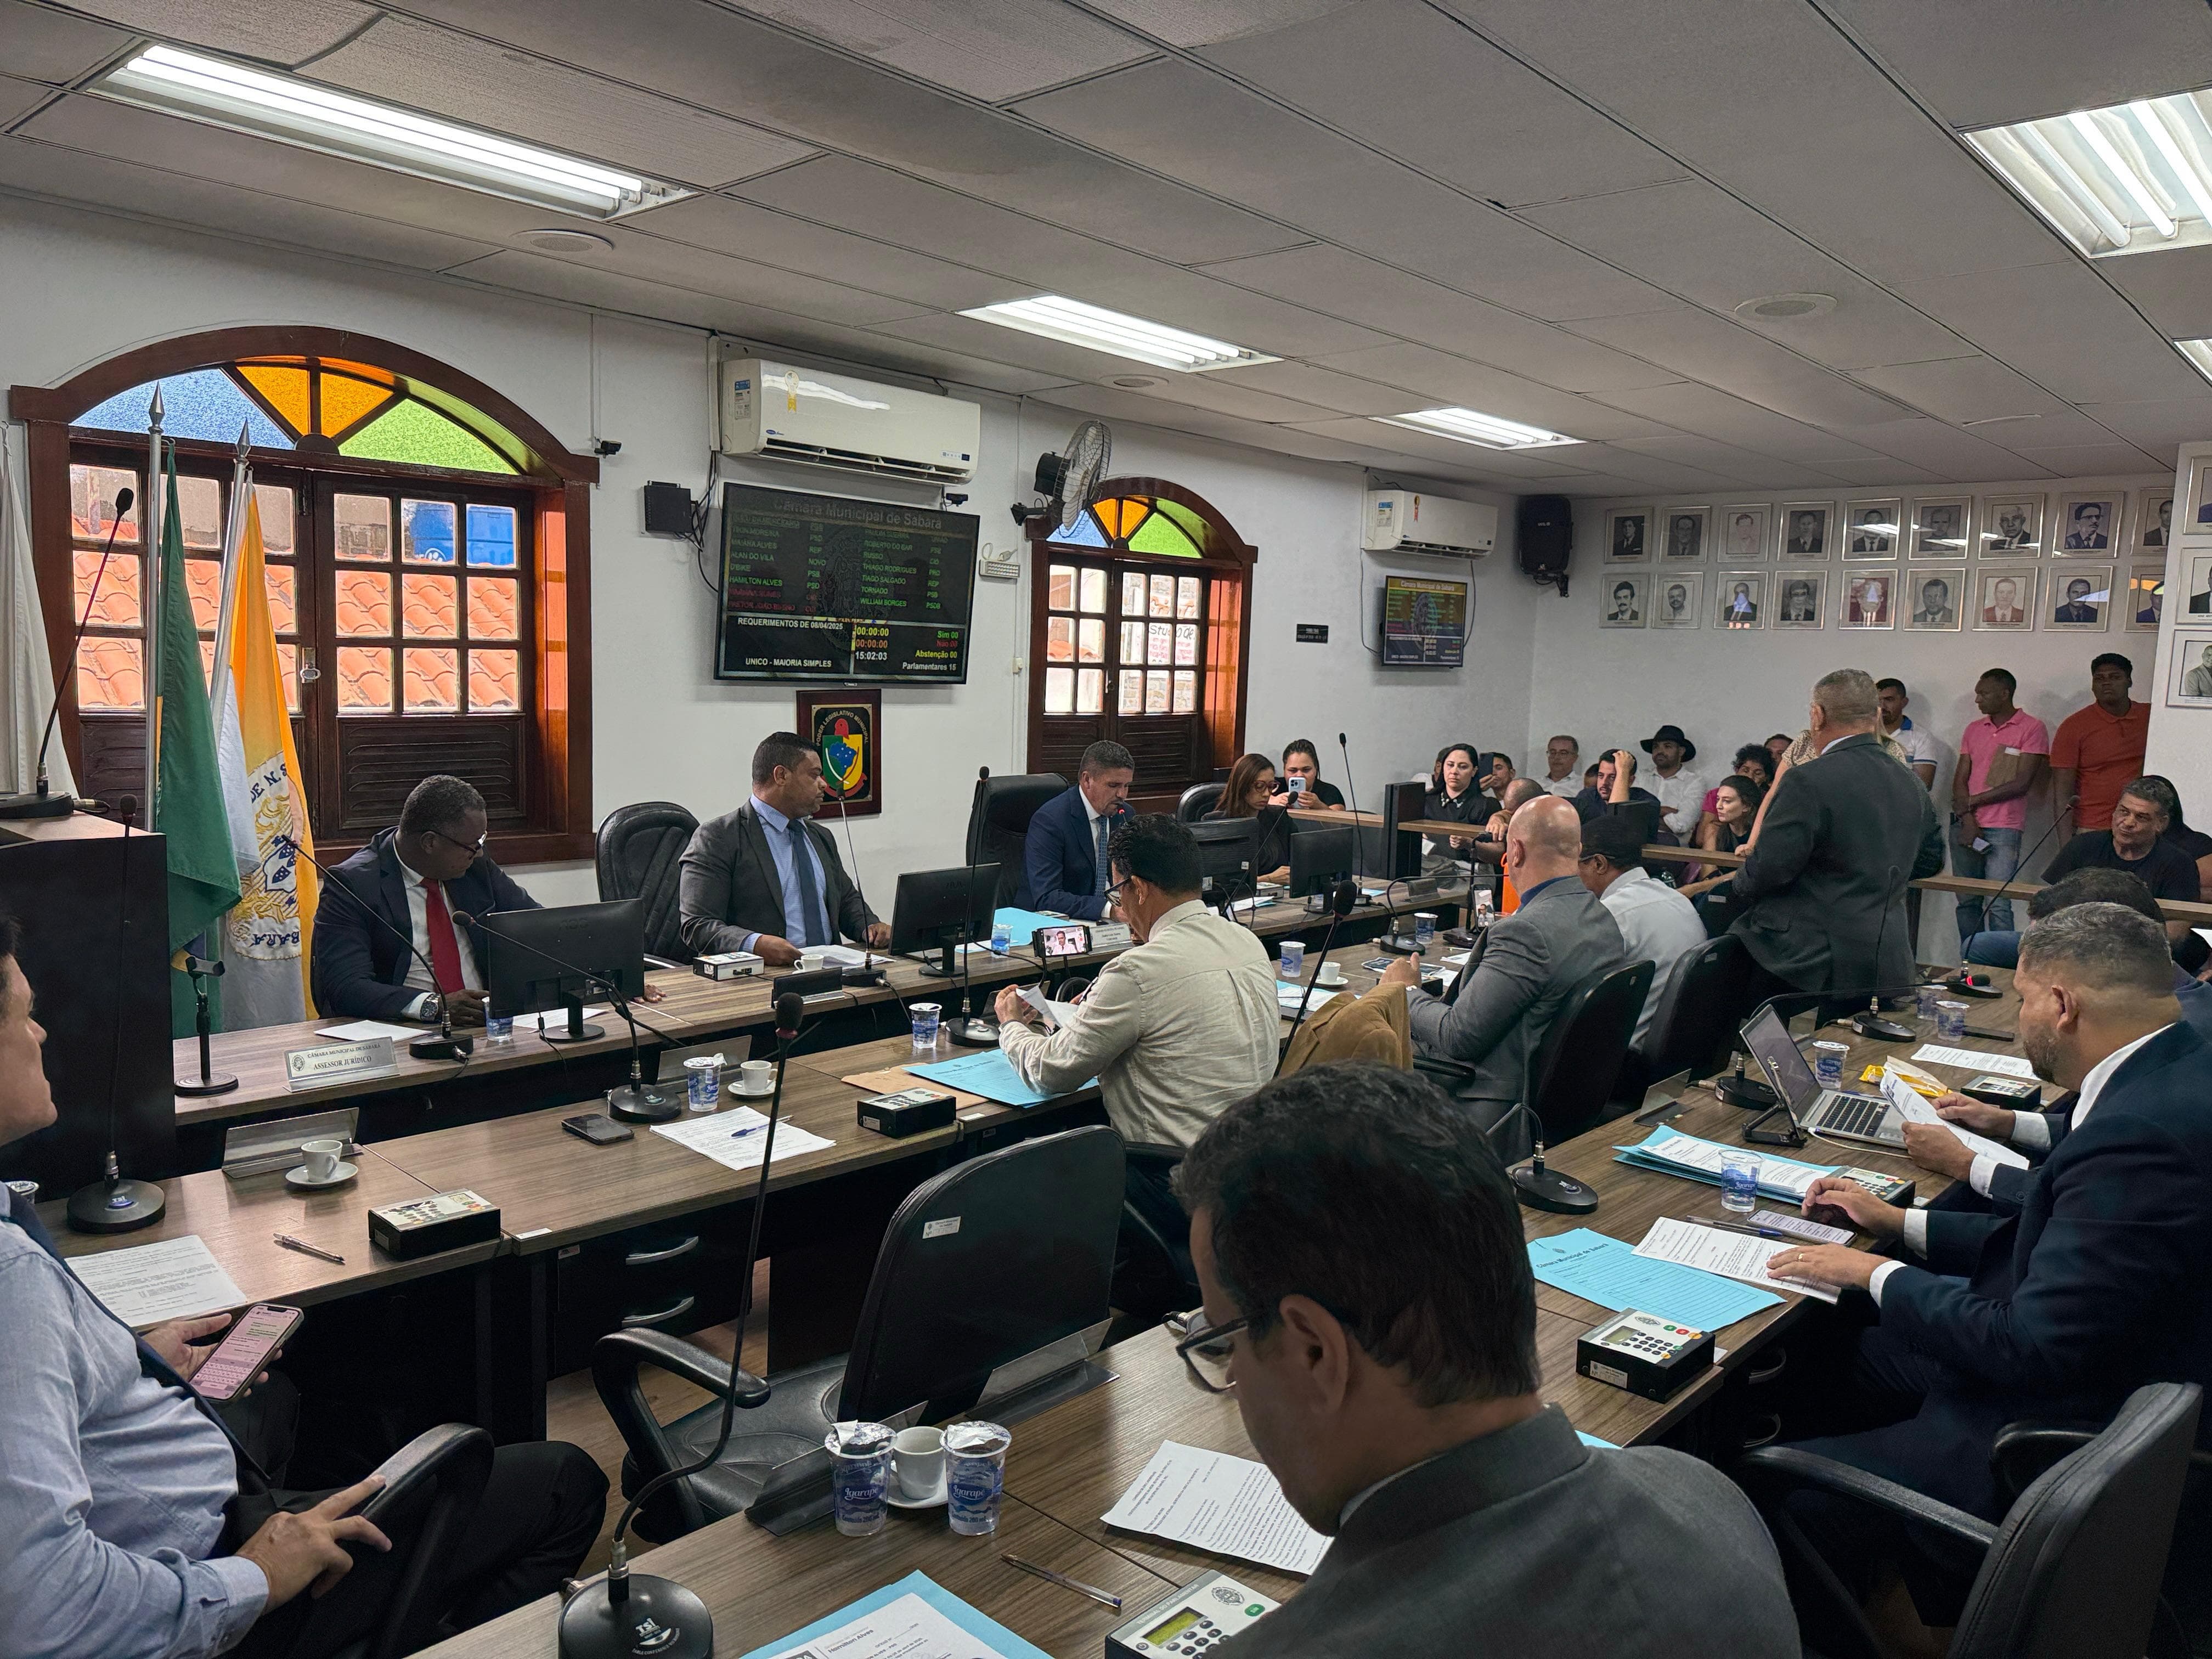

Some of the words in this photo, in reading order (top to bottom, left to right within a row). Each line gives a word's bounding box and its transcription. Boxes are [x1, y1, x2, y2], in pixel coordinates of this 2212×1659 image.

[826, 503, 883, 522] Municipal
[886, 512, 901, 523] de
[905, 514, 942, 529] Sabará
[863, 551, 884, 560] RUSSO
[862, 563, 884, 572] THIAGO
[884, 565, 917, 574] RODRIGUES
[729, 576, 761, 585] HAMILTON
[762, 578, 783, 586] ALVES
[862, 574, 879, 583] TIAGO
[879, 577, 906, 585] SALGADO
[861, 586, 888, 595] TORNADO
[860, 597, 883, 606] WILLIAM
[884, 599, 907, 607] BORGES
[738, 617, 799, 628] REQUERIMENTOS
[799, 620, 810, 629] DE
[810, 622, 843, 630] 08/04/2025
[856, 626, 889, 636] 00:00:00
[855, 639, 888, 648] 00:00:00
[855, 651, 887, 661] 15:02:03
[915, 650, 949, 659] Abstenção
[774, 659, 802, 667] MAIORIA
[803, 659, 832, 668] SIMPLES
[902, 662, 947, 671] Parlamentares
[816, 724, 825, 746] PODER
[823, 710, 854, 725] LEGISLATIVO
[854, 715, 868, 744] MUNICIPAL
[329, 1047, 354, 1057] MUNICIPAL
[362, 1042, 381, 1051] SABARÁ
[313, 1059, 343, 1071] ASSESSOR
[343, 1055, 372, 1066] JURÍDICO
[635, 1617, 656, 1633] TSI
[827, 1638, 857, 1654] Hamilton
[856, 1629, 874, 1640] Alves
